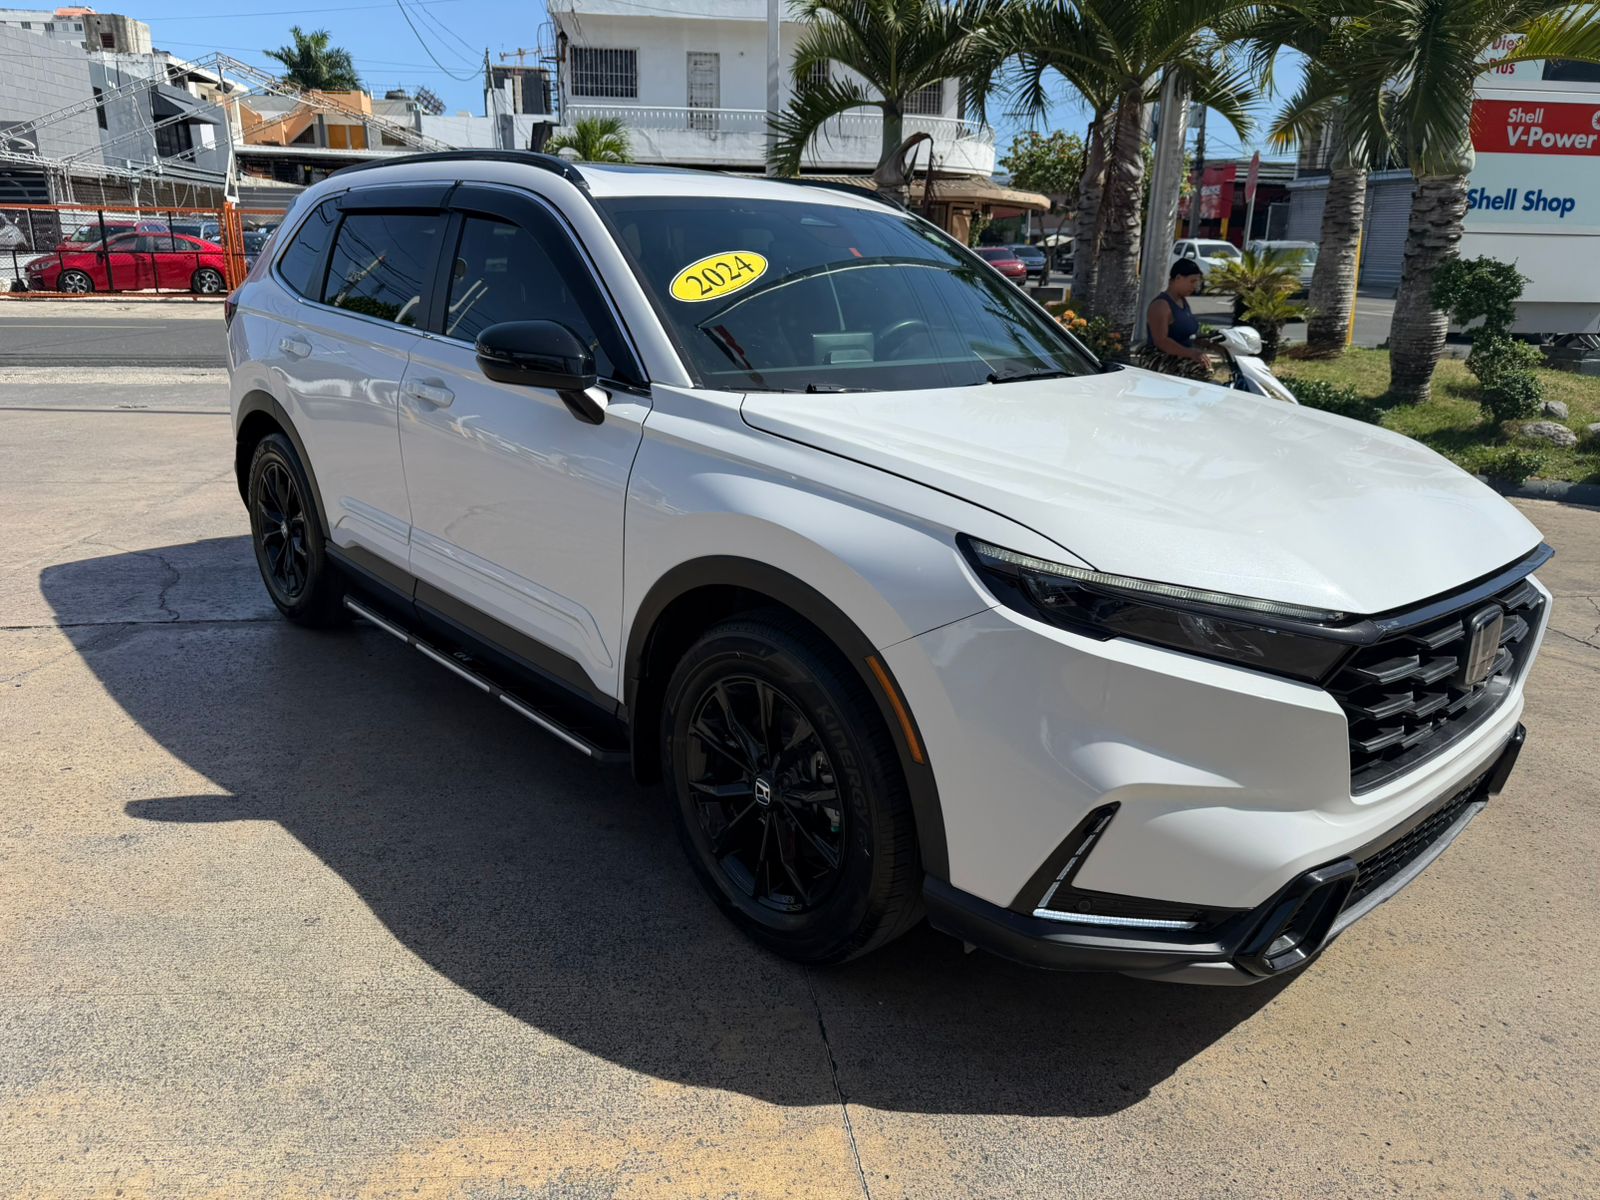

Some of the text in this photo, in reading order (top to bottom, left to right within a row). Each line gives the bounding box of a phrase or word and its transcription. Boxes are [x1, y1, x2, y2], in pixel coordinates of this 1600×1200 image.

[1507, 107, 1544, 123] Shell
[1507, 125, 1598, 149] V-Power
[1467, 187, 1576, 218] Shell Shop
[686, 256, 754, 295] 2024
